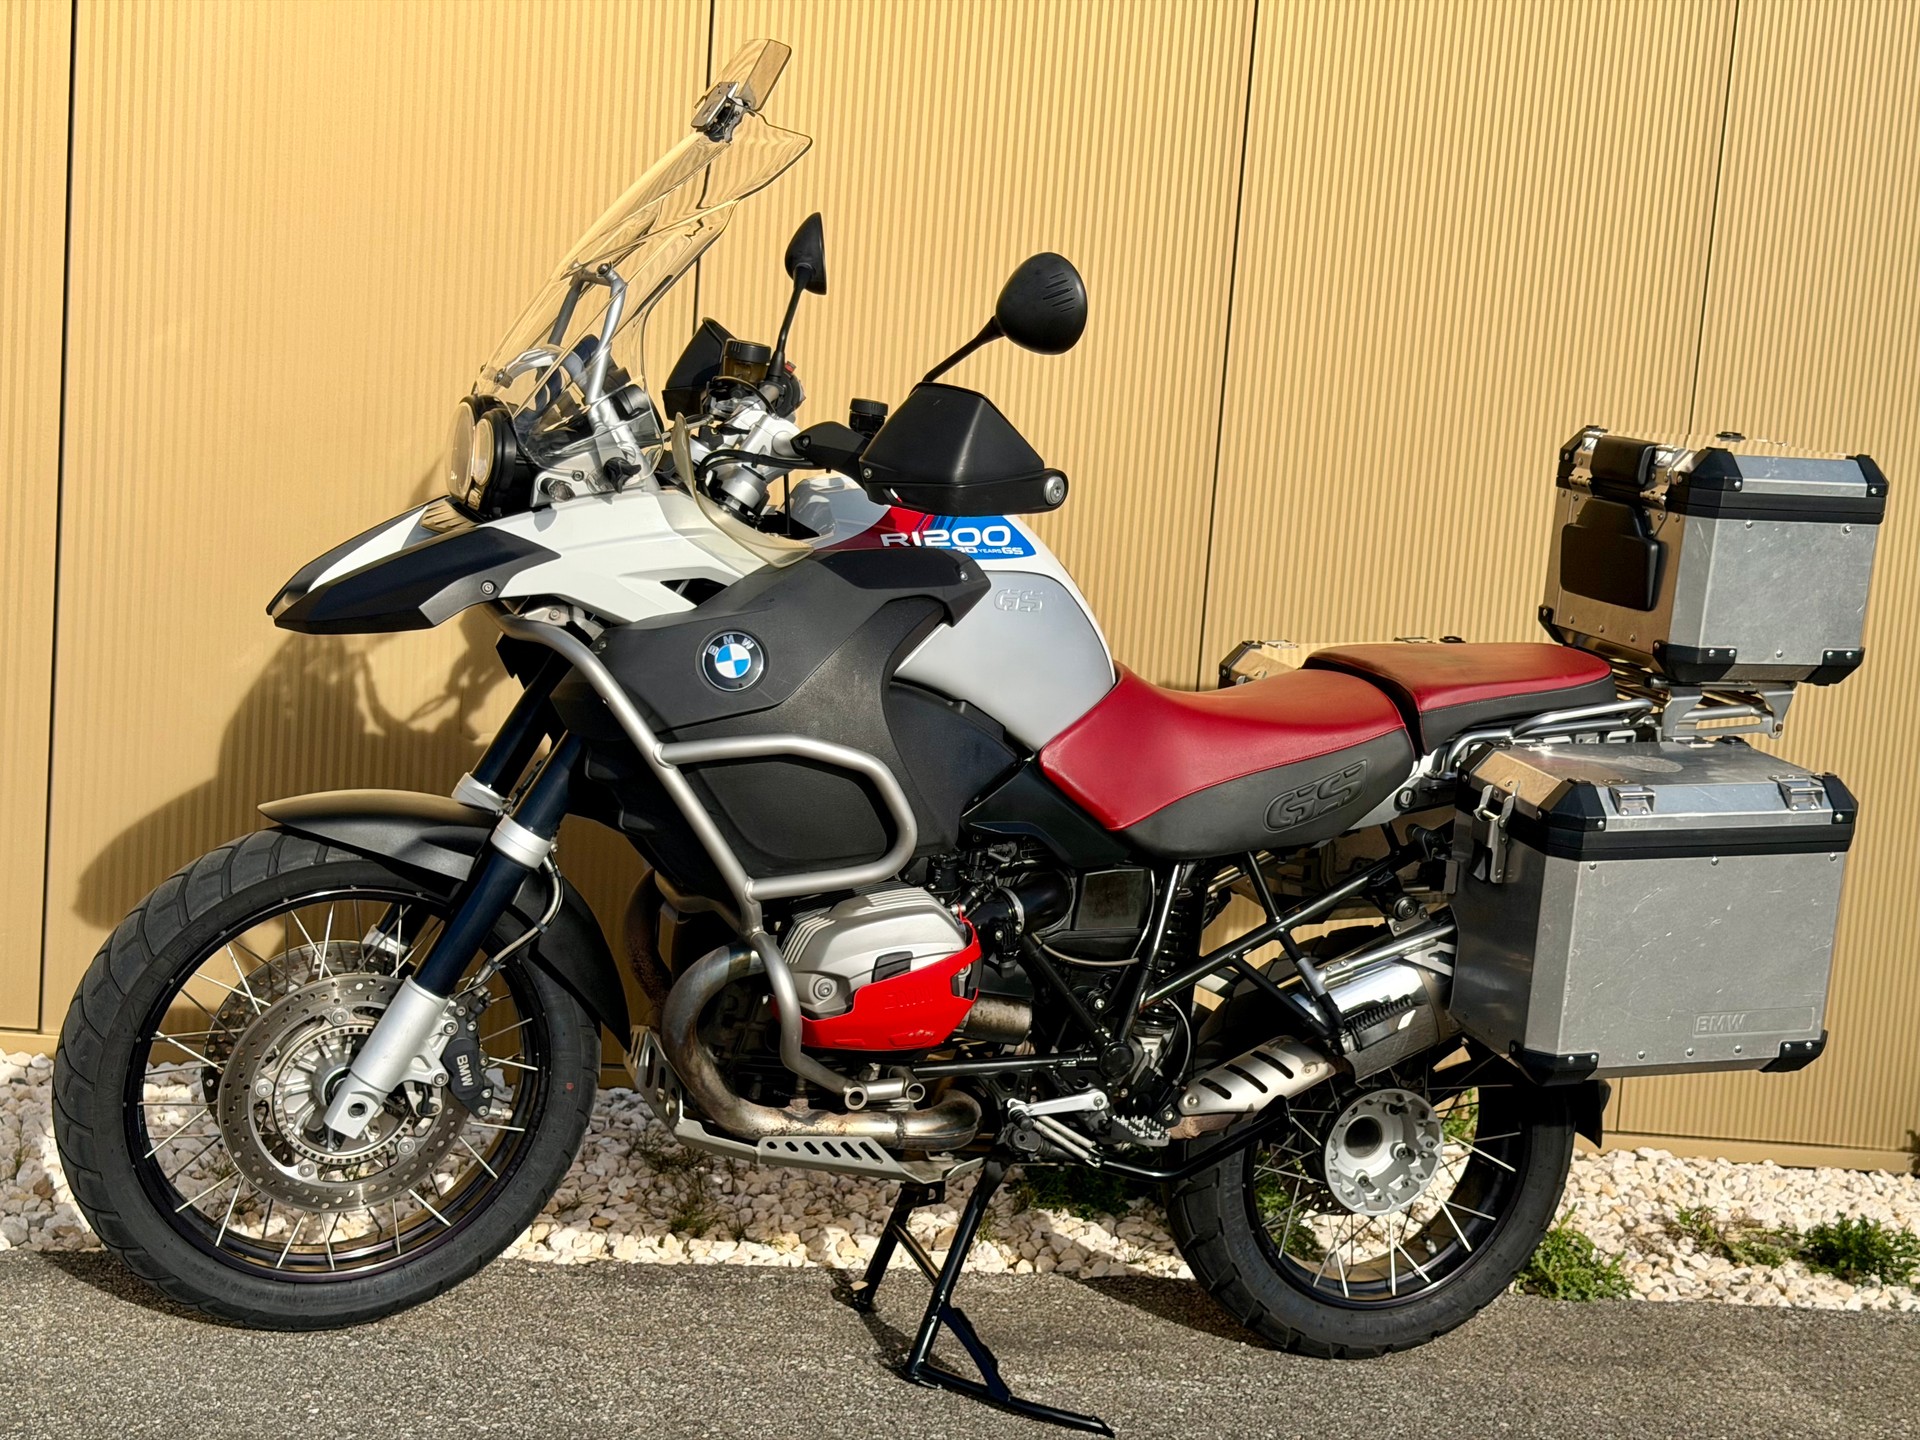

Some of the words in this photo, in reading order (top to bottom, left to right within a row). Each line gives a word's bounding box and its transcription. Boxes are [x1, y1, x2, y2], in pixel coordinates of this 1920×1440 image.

[880, 525, 1011, 547] R1200
[1001, 546, 1024, 555] GS
[994, 589, 1043, 612] GS
[707, 634, 755, 656] BMW
[1266, 762, 1364, 830] GS
[1695, 1013, 1746, 1033] BMW
[456, 1054, 474, 1086] BMW
